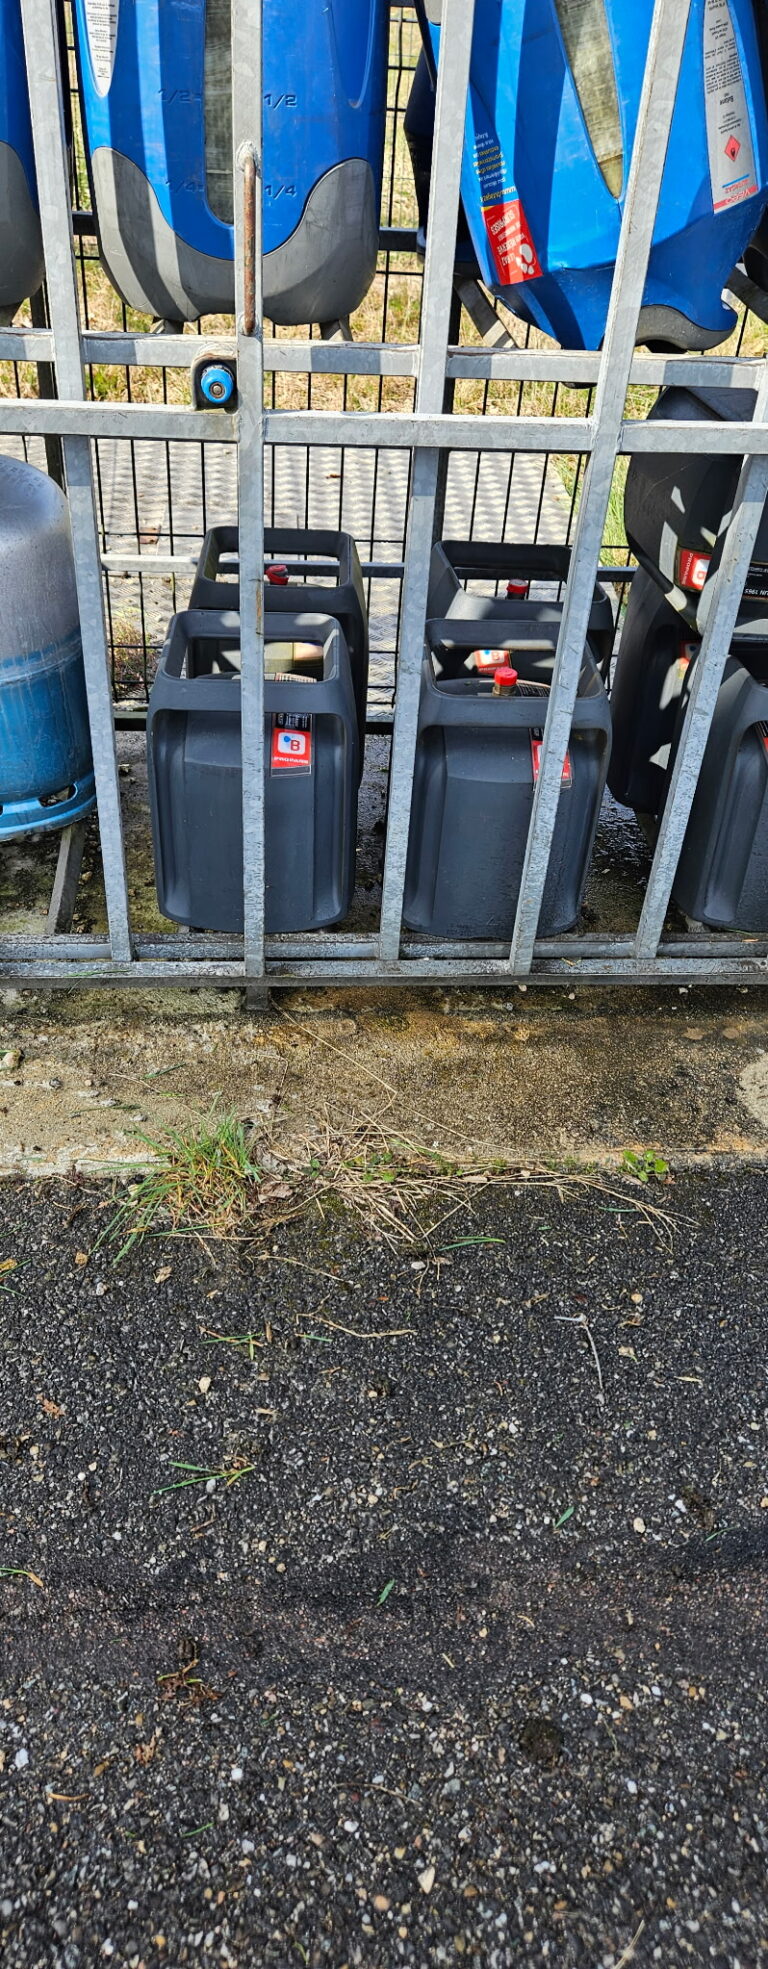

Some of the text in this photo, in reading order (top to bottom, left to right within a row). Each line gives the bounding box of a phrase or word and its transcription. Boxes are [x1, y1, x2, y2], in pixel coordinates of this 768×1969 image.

[157, 88, 194, 104] 1/2
[263, 92, 298, 111] 1/2
[263, 184, 298, 201] 1/4
[291, 740, 300, 751] B
[274, 756, 308, 764] PROPANE
